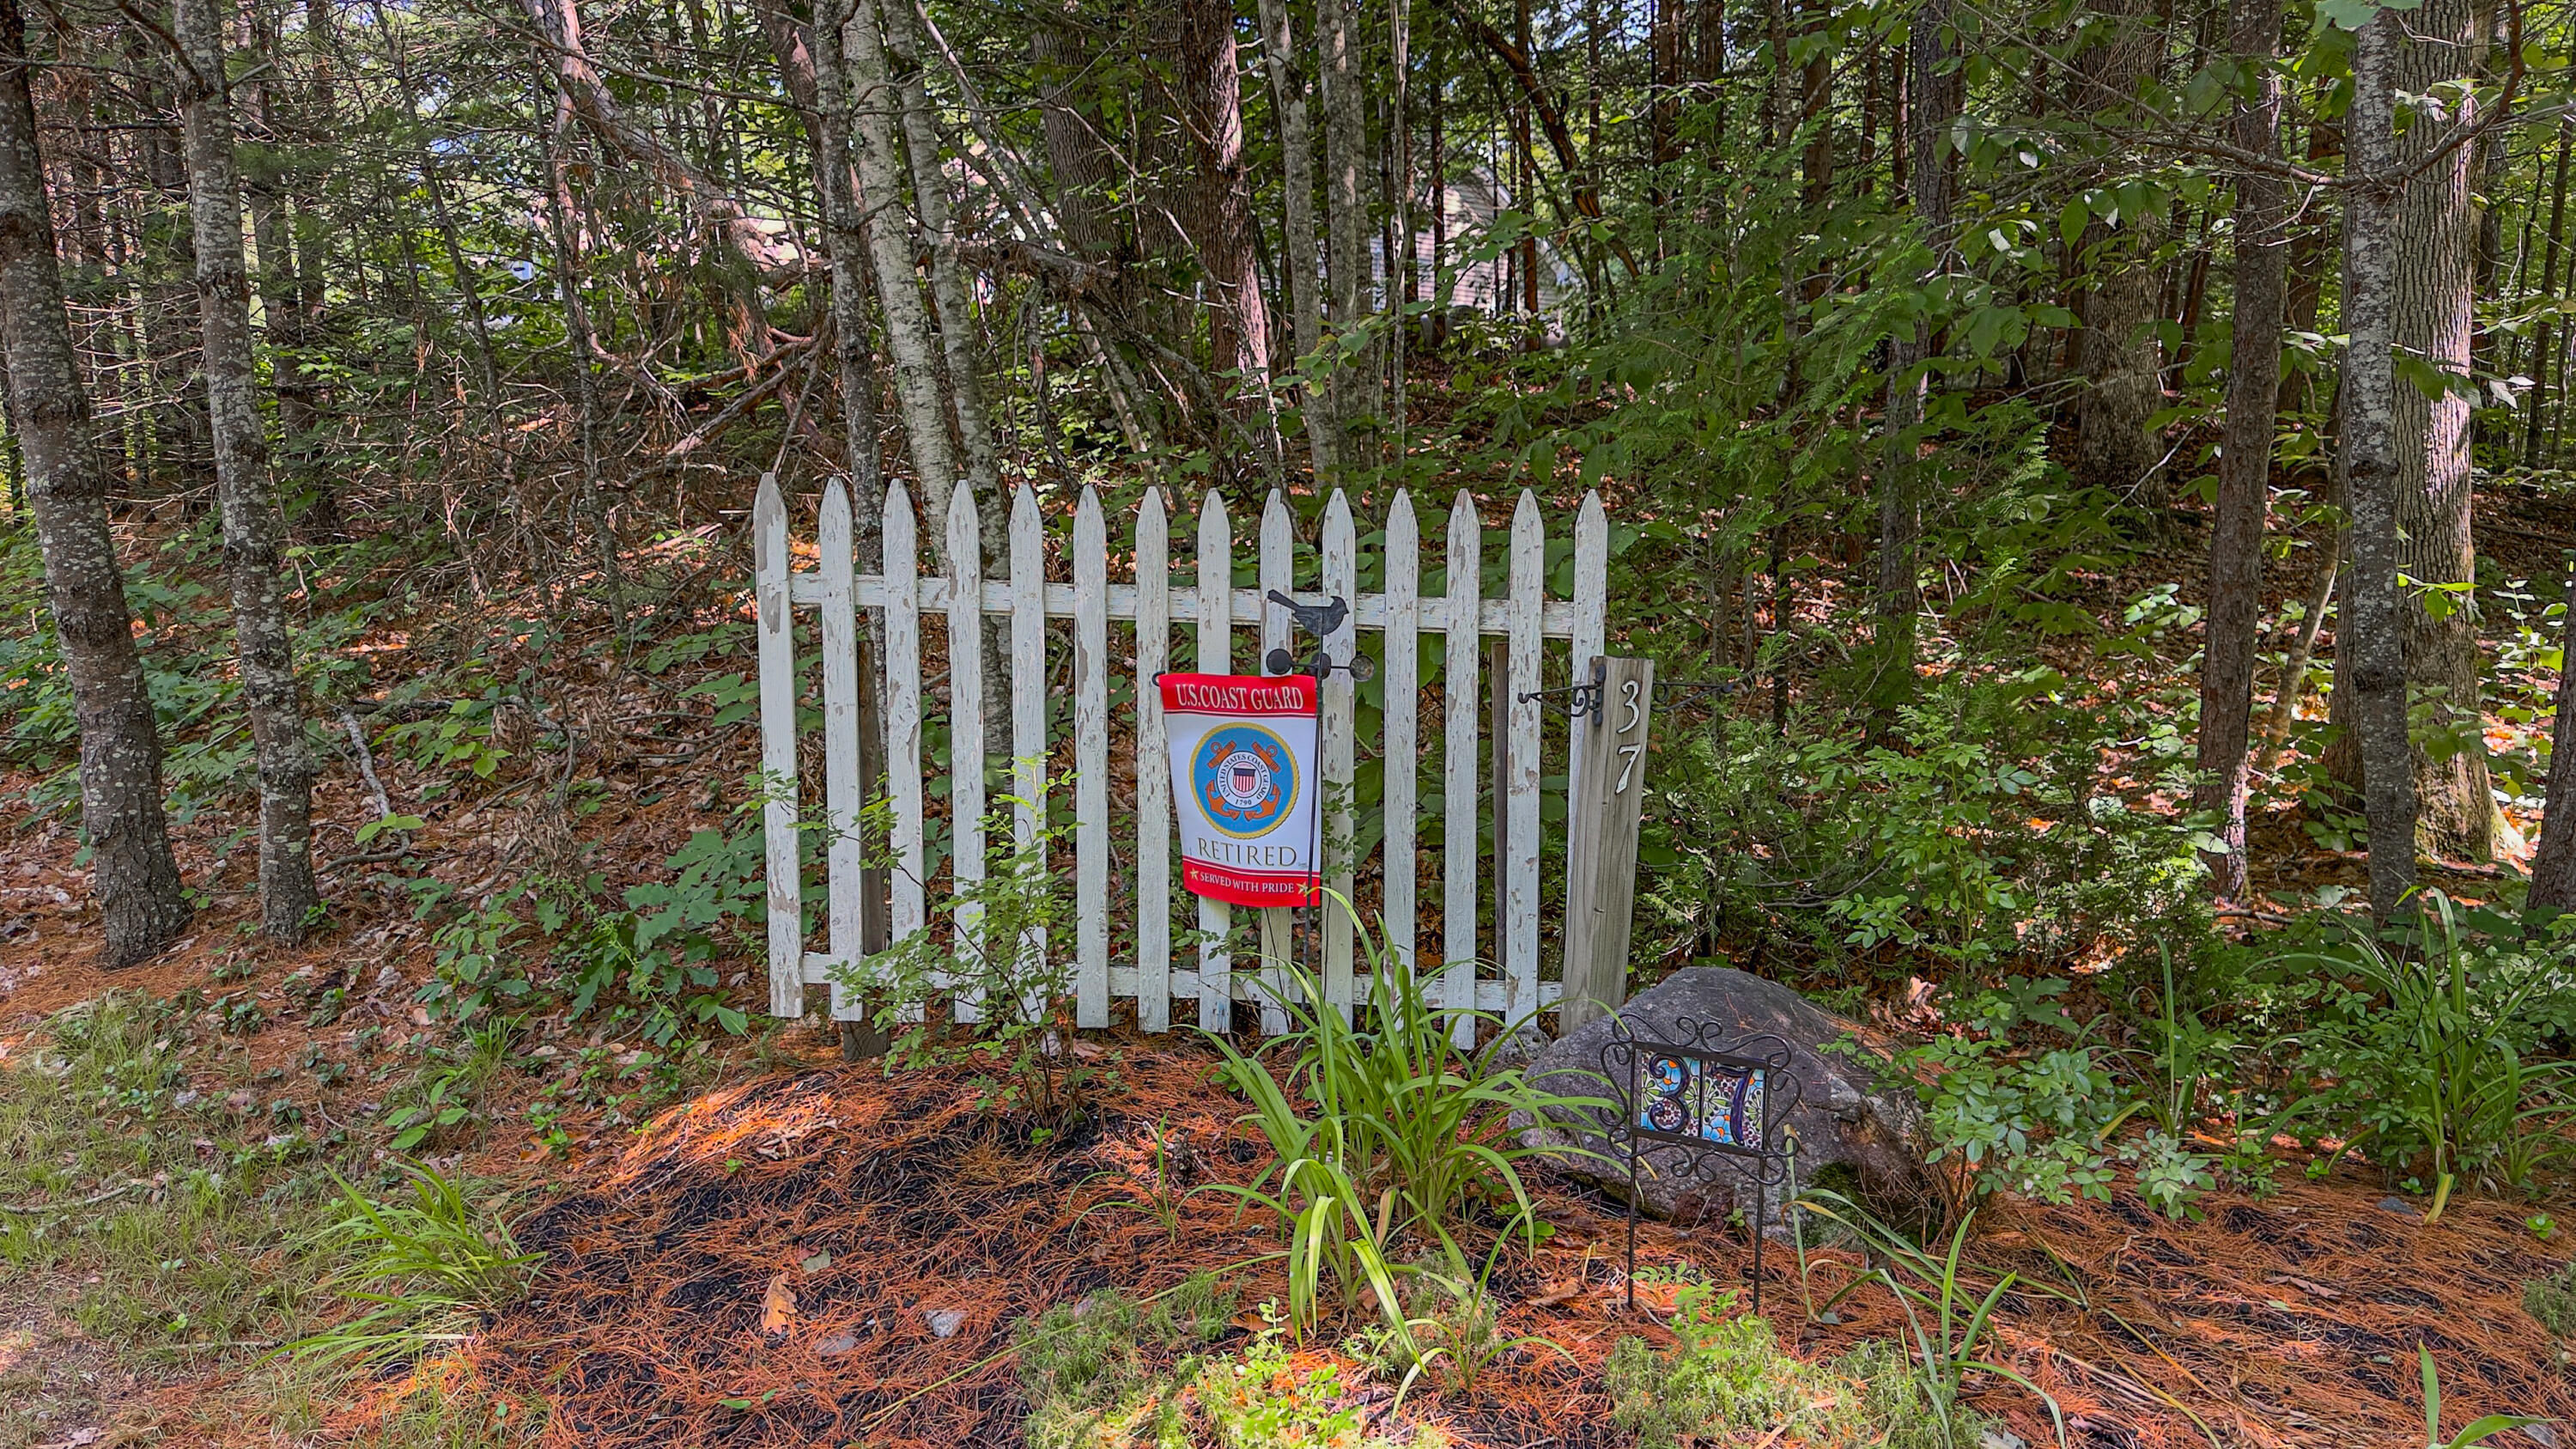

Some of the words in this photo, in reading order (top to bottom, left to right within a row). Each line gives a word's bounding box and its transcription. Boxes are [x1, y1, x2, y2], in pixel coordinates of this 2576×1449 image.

[1250, 686, 1304, 710] GUARD
[1615, 679, 1642, 795] 37
[1224, 754, 1246, 770] STATES
[1247, 754, 1267, 773] COAST
[1218, 769, 1230, 797] UNITED
[1256, 774, 1269, 800] GUARD
[1197, 837, 1297, 867] RETIRED
[1200, 871, 1231, 887] SERVED
[1232, 879, 1259, 892] WITH
[1261, 882, 1295, 893] PRIDE
[1649, 1052, 1754, 1146] 37
